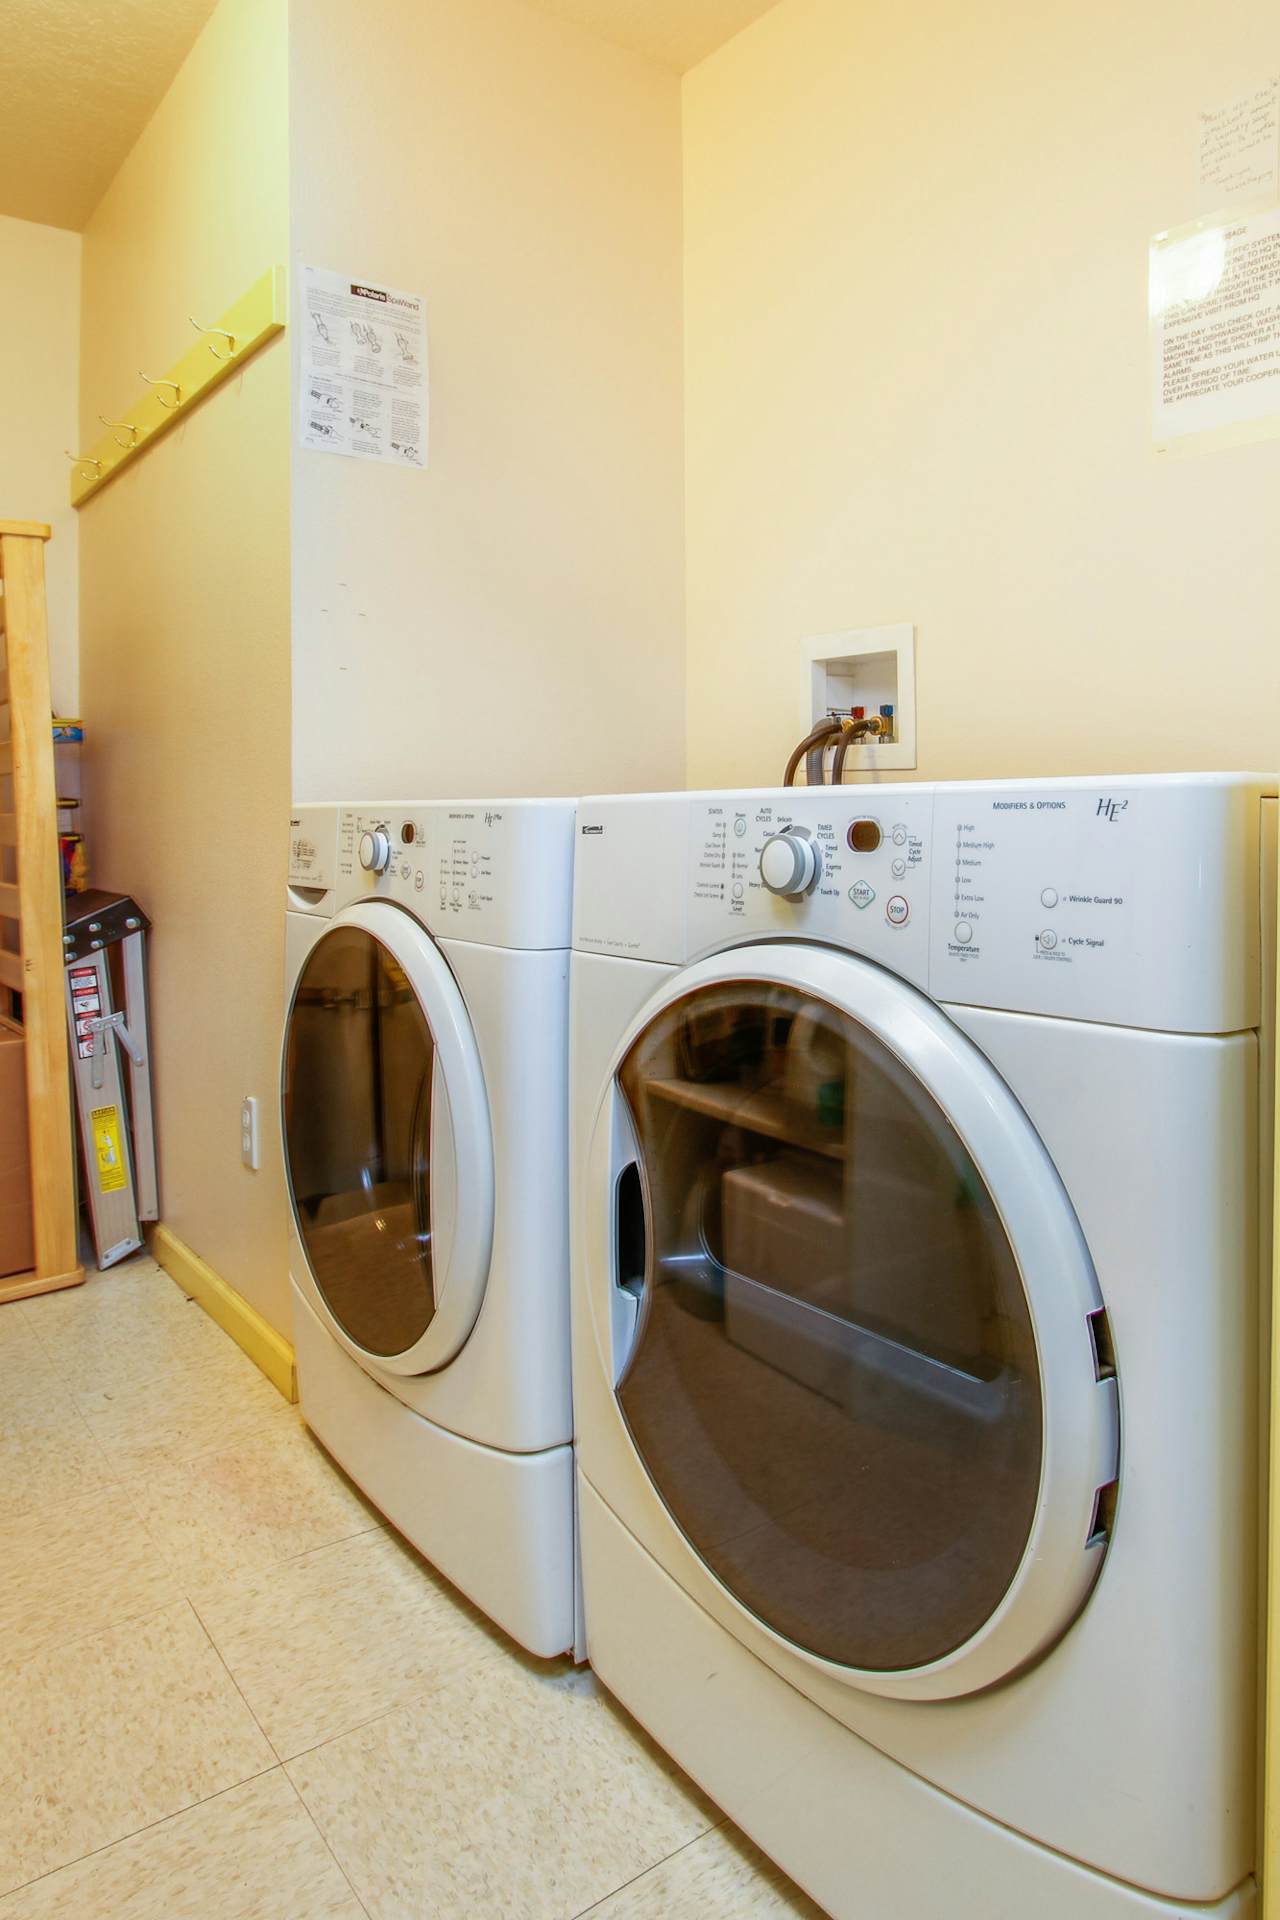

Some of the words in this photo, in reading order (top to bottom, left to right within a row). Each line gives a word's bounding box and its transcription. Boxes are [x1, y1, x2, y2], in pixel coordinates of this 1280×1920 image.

[993, 802, 1027, 810] MODIFIERS
[1037, 801, 1066, 809] OPTIONS
[1094, 896, 1112, 904] Guard
[890, 905, 904, 913] STOP
[1068, 937, 1084, 945] Cycle
[1086, 939, 1104, 948] Signal
[948, 943, 979, 953] Temperature
